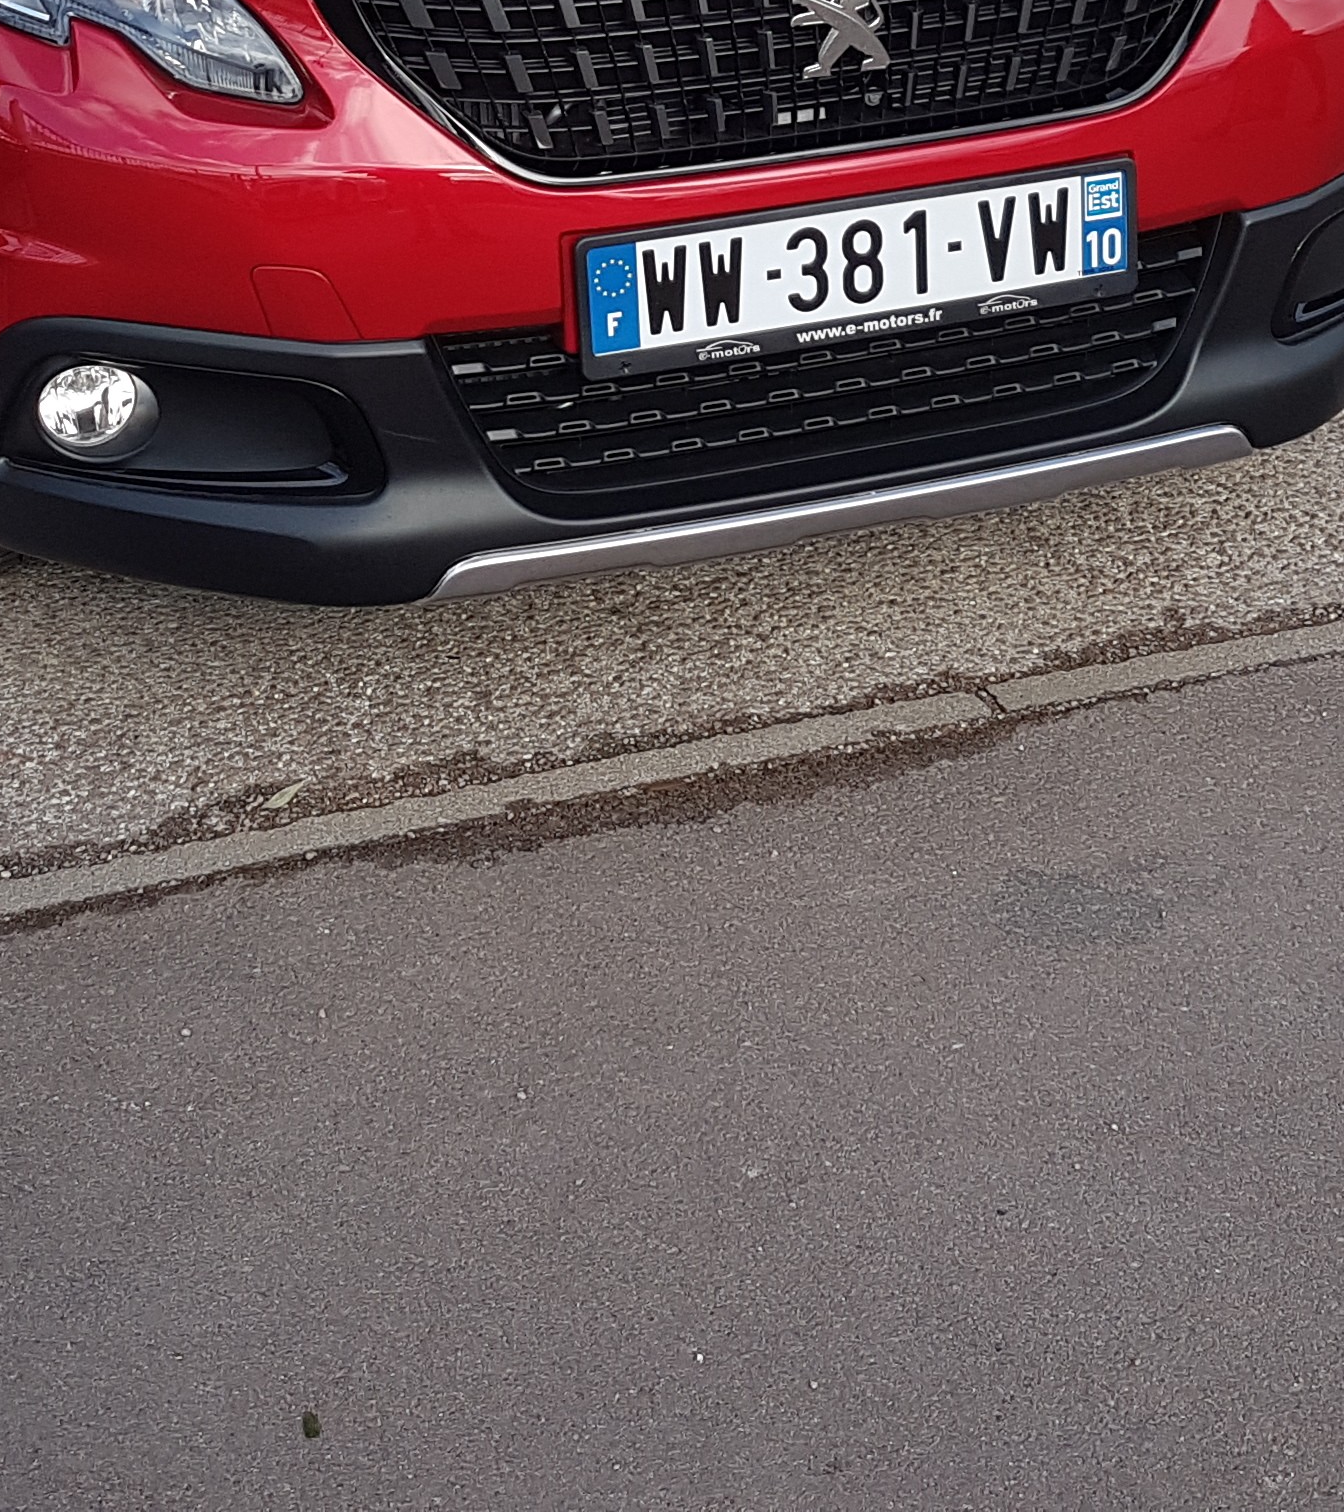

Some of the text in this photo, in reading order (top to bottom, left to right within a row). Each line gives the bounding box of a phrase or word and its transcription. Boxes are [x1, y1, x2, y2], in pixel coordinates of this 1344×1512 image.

[1088, 180, 1119, 193] Grand
[1088, 191, 1119, 212] Est
[642, 186, 1069, 336] WW-381-VW
[1086, 227, 1122, 268] 10
[605, 310, 623, 338] F
[796, 308, 943, 344] www.e-motors.fr
